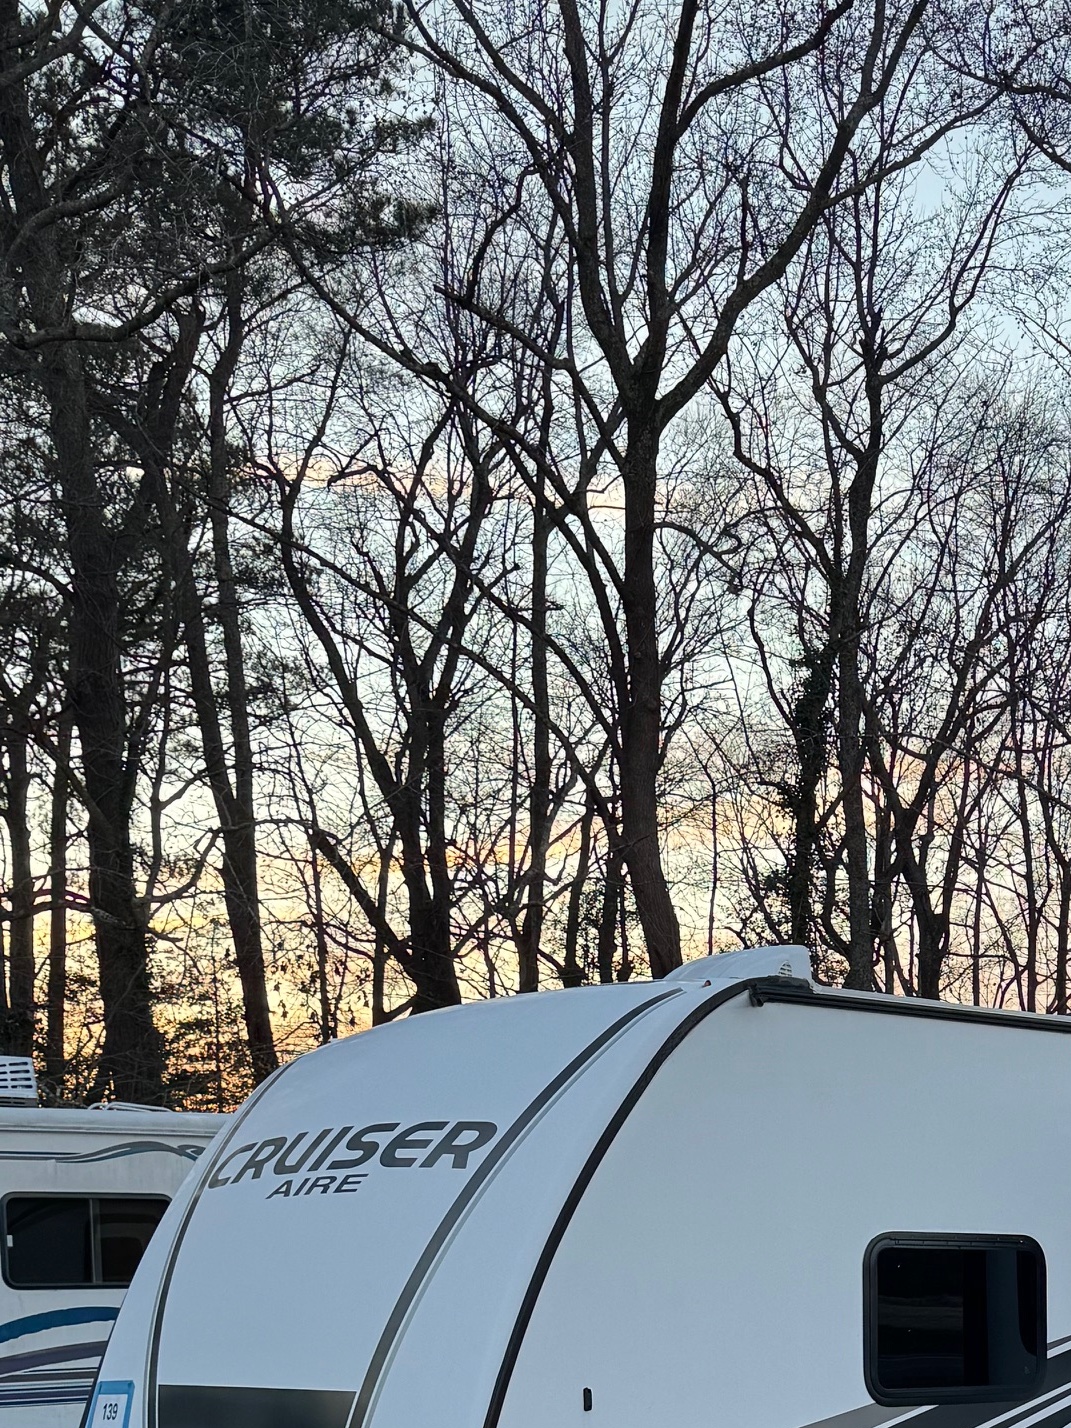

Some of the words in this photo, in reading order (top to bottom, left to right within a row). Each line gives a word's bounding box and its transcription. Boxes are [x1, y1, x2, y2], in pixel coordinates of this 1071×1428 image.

[208, 1121, 498, 1189] CRUISER
[265, 1173, 369, 1199] AIRE
[103, 1403, 118, 1420] 139
